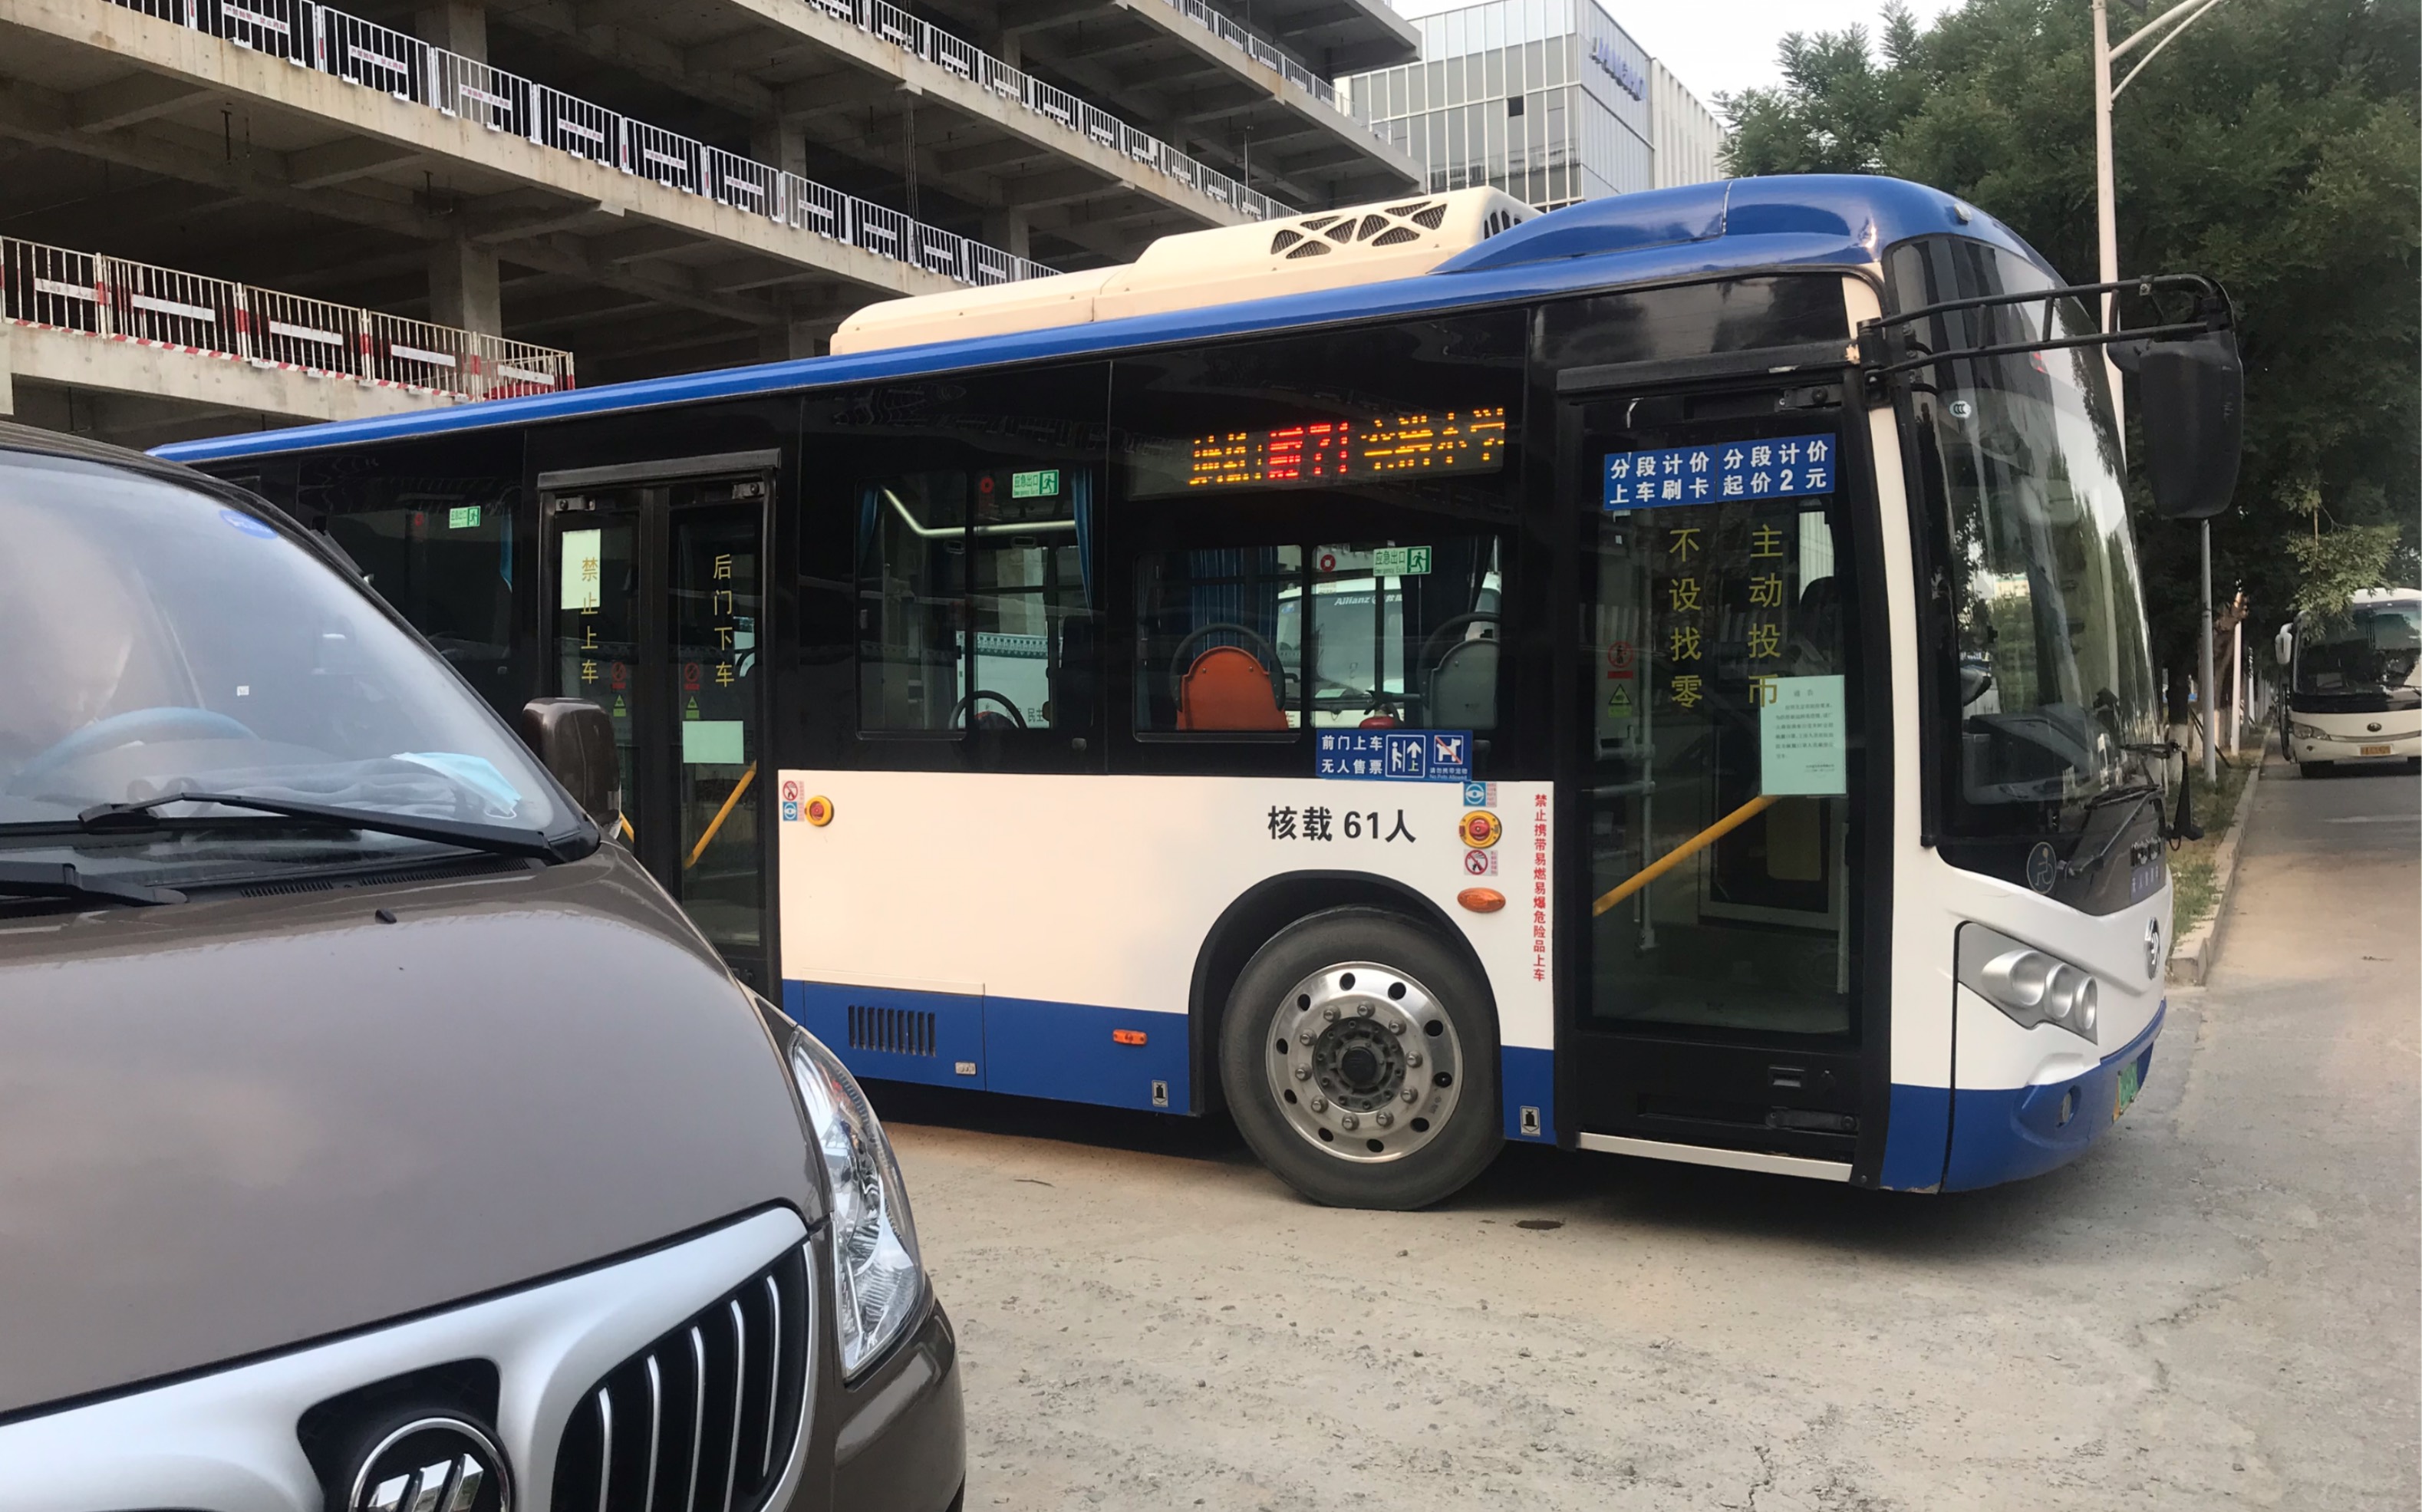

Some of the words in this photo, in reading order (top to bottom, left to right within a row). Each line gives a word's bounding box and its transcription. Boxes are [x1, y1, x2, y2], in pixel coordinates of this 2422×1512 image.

[1610, 451, 1710, 479] 分段计价
[1723, 440, 1828, 470] 分段计价
[1610, 478, 1709, 504] 上车刷卡
[1723, 468, 1827, 496] 起价2元
[1334, 595, 1370, 606] Allianz
[1669, 528, 1703, 708] 不设找零
[1748, 525, 1784, 707] 主动投币
[581, 557, 598, 684] 禁止上车
[713, 554, 735, 687] 后门下车
[1321, 736, 1383, 751] 前门上车
[1321, 759, 1383, 775] 无人售票
[1408, 760, 1419, 772] 上
[1533, 793, 1547, 982] 禁止携带易燃易爆危险品上车
